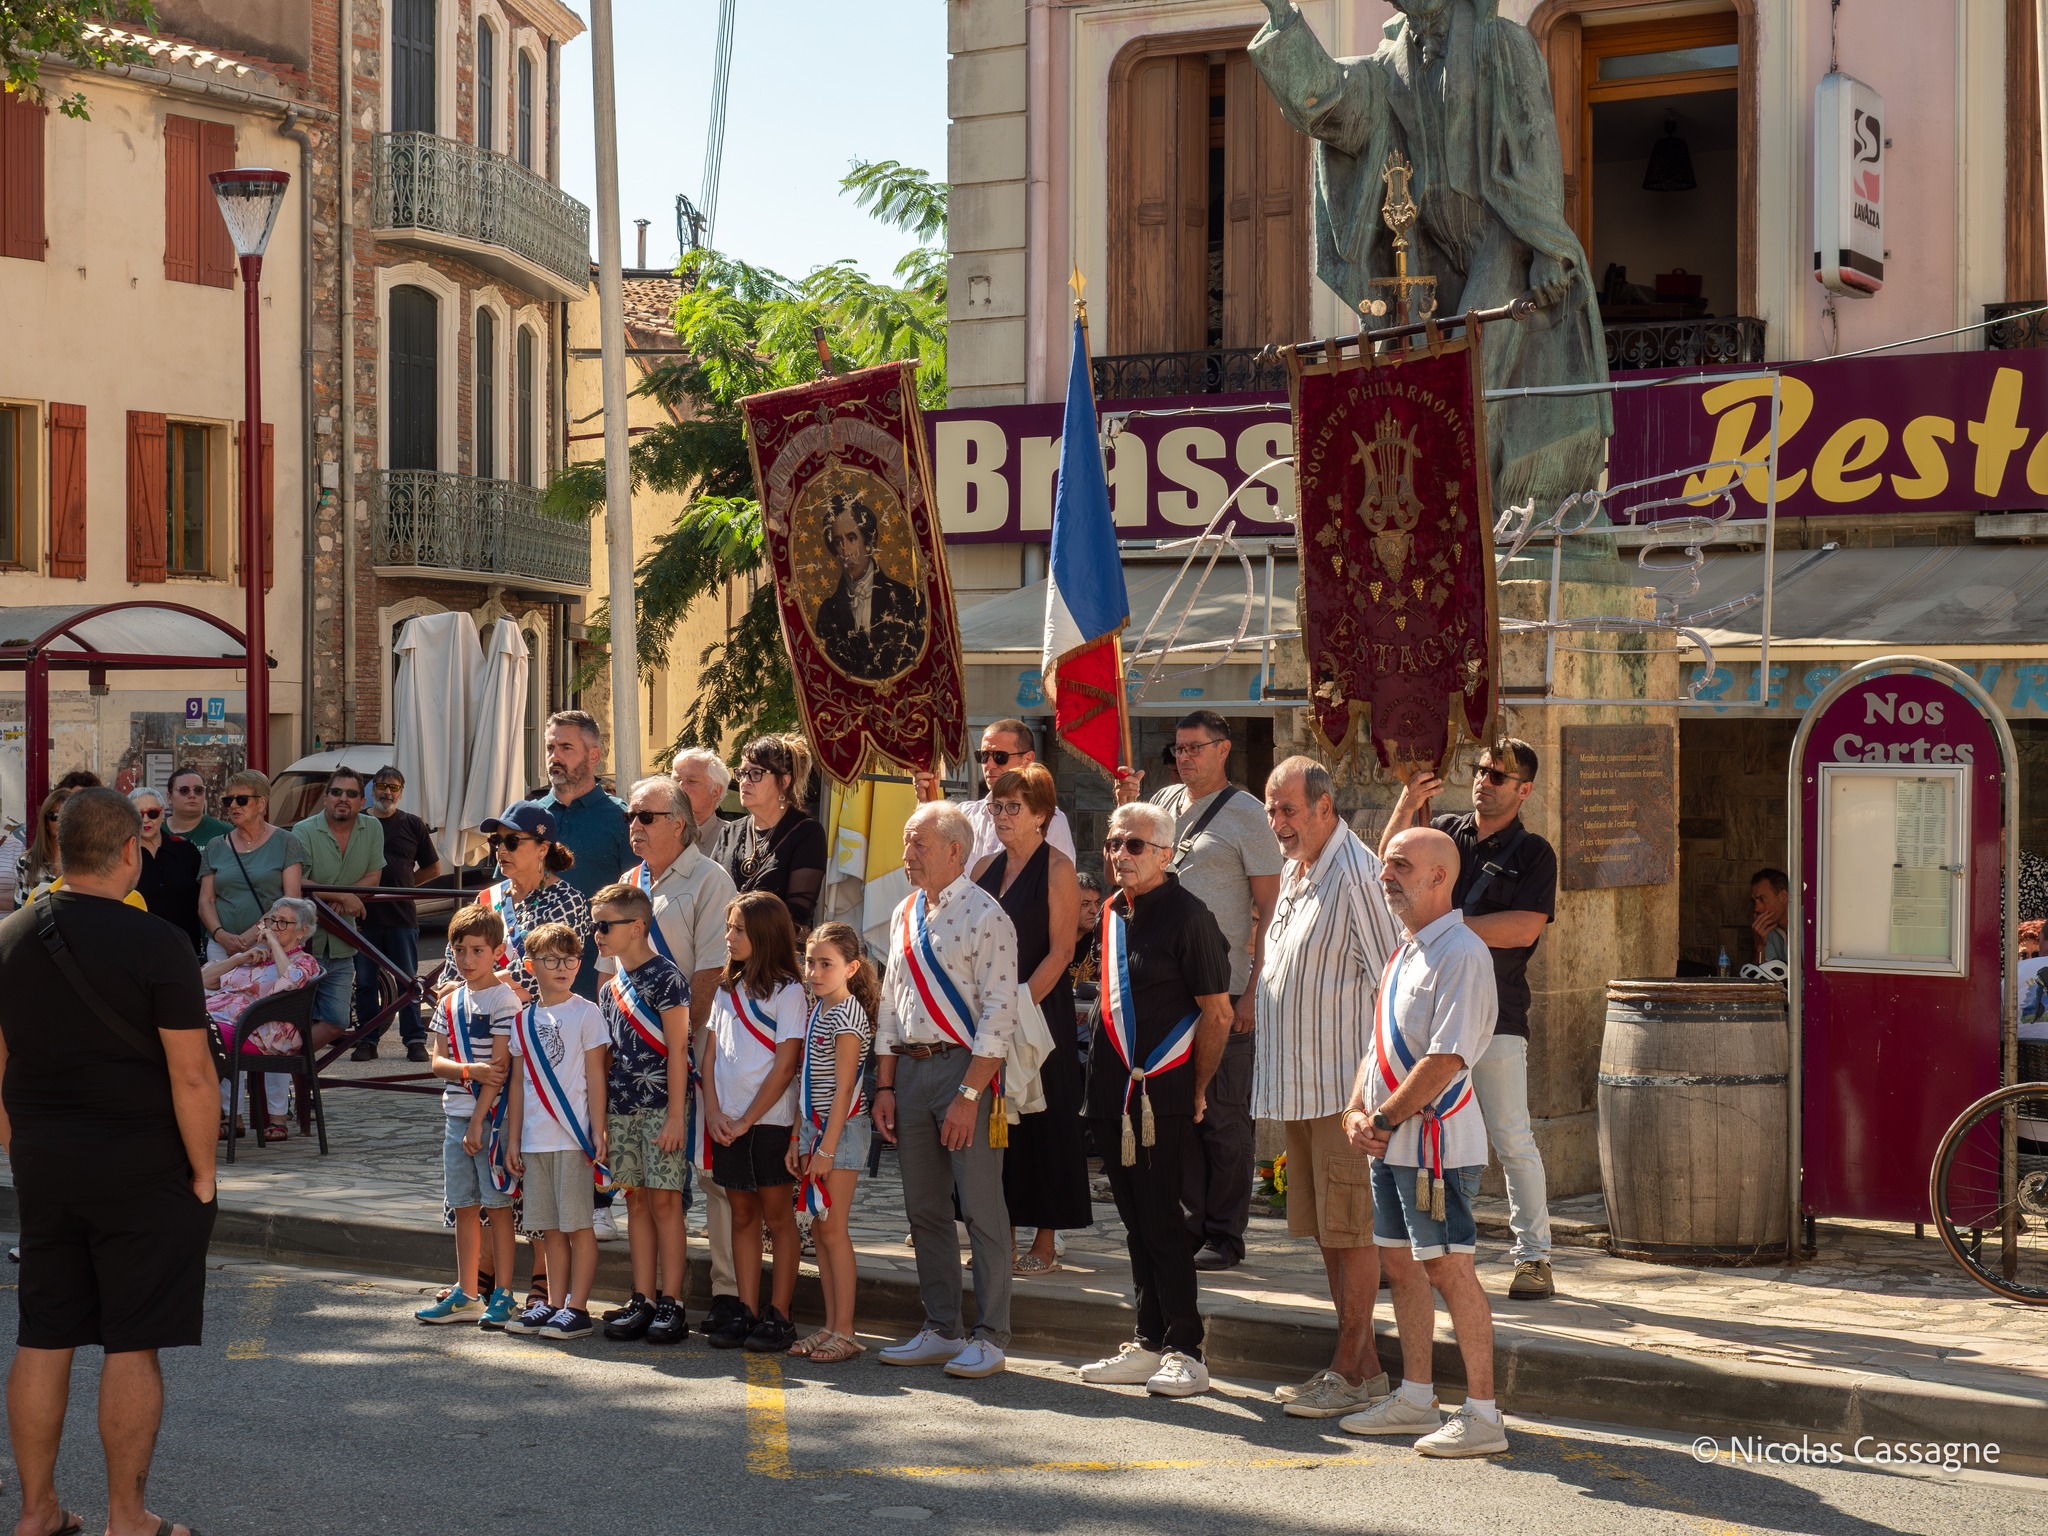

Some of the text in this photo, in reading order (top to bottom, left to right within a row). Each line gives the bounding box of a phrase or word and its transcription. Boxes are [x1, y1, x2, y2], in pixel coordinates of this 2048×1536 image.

[1854, 201, 1880, 230] LAVAZZA
[844, 420, 899, 462] ARAGO
[190, 701, 199, 717] 9
[210, 702, 222, 716] 17
[1863, 692, 1945, 725] Nos
[1833, 733, 1975, 764] Cartes
